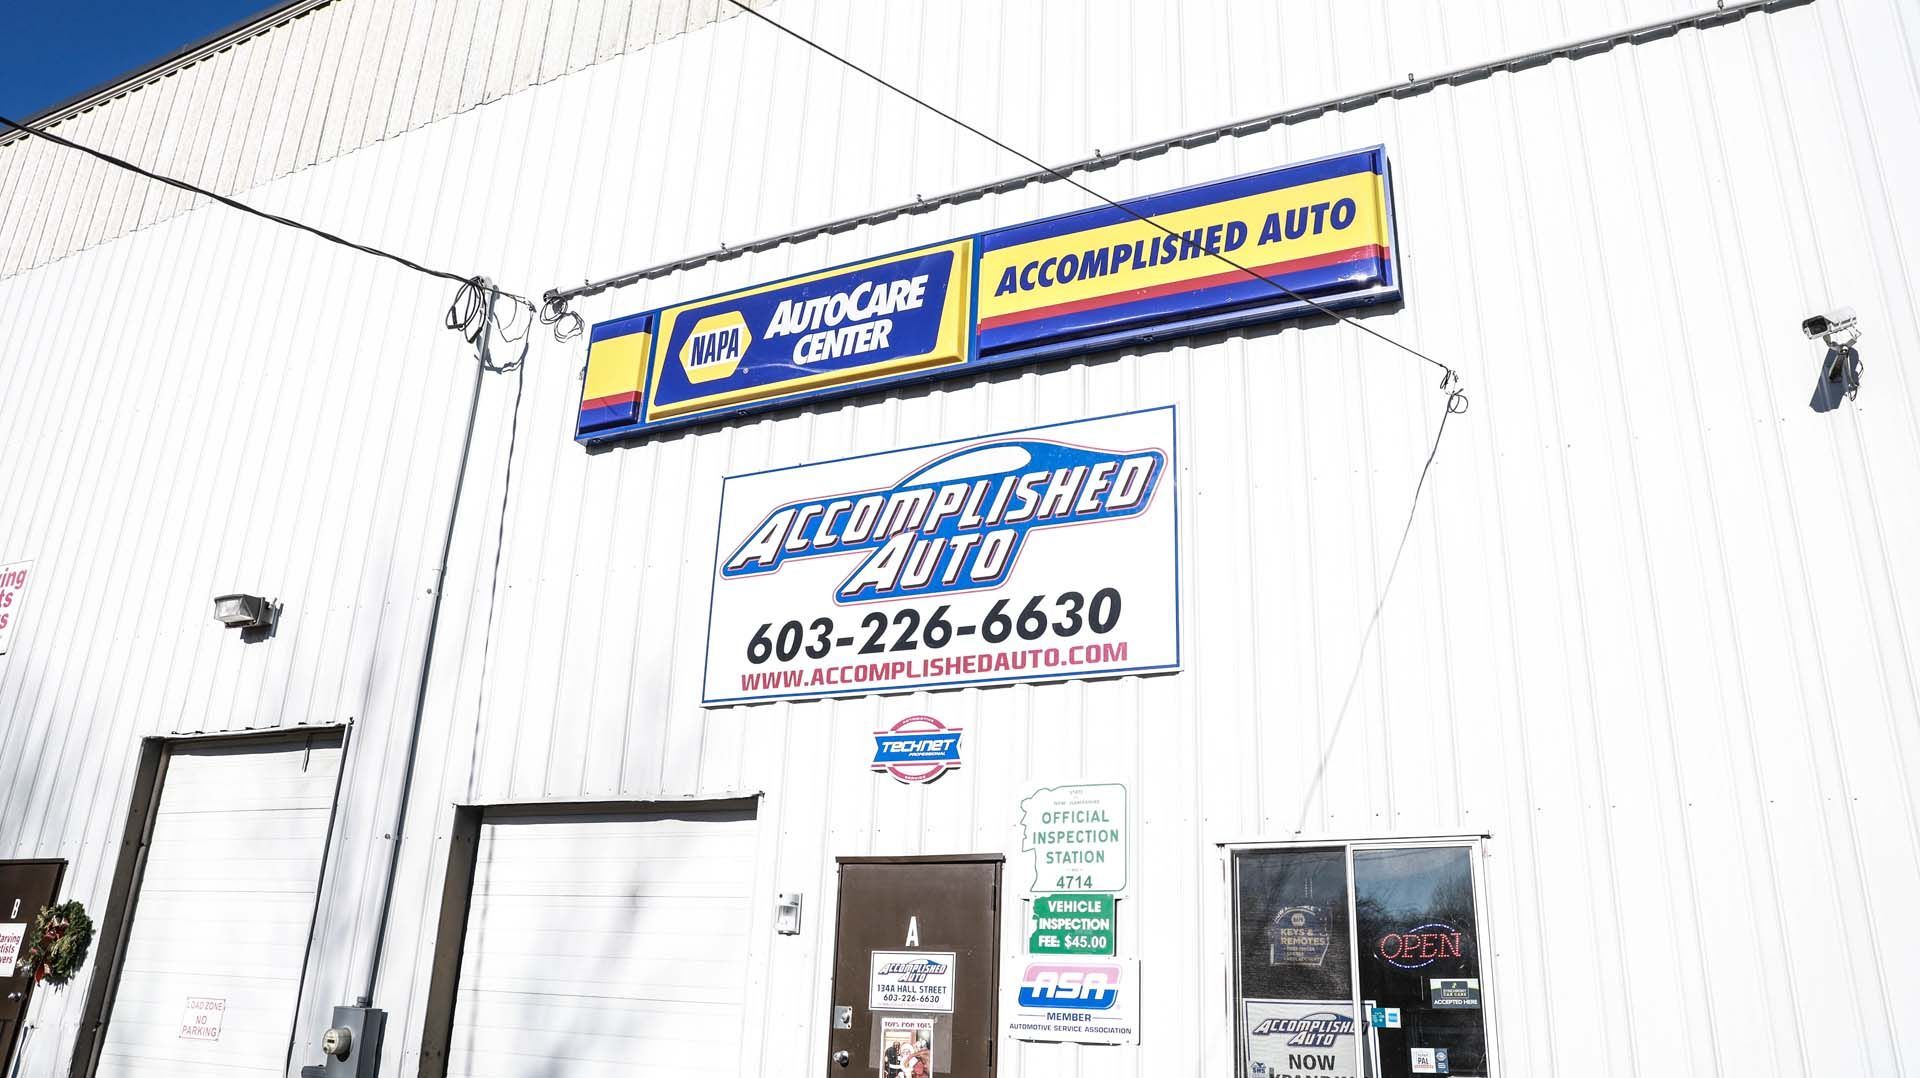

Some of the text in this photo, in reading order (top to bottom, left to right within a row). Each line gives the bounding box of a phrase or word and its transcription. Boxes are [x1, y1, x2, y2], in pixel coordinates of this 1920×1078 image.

[994, 197, 1357, 297] ACCOMPLISHED AUTO
[763, 274, 929, 340] AUTOCARE
[690, 327, 739, 367] NAPA
[792, 318, 893, 365] CENTER
[728, 455, 1158, 570] ACCOMPLISHED
[841, 529, 1017, 597] AUTO
[746, 587, 1122, 664] 603-226-6630
[741, 641, 1128, 691] WWW.ACCOMPLISHEDAUTO.COM
[1041, 809, 1110, 824] OFFICIAL
[1032, 829, 1119, 844] INSPECTION
[1046, 850, 1105, 864] STATION
[1056, 875, 1093, 889] 4714
[10, 898, 21, 919] B
[1048, 900, 1102, 913] VEHICLE
[905, 915, 919, 947] A
[1039, 918, 1110, 931] INSPECTION
[1280, 928, 1304, 936] KEYS
[1064, 934, 1107, 949] $45.00
[1280, 937, 1326, 945] REMOTES
[1380, 933, 1462, 959] OPEN
[878, 963, 948, 975] ACCOMPLISHED
[898, 973, 928, 983] AUTO
[1031, 971, 1109, 1000] ASA
[877, 984, 947, 995] 134A HALL STREET
[883, 993, 940, 1003] 603-226-6630
[205, 1001, 223, 1011] ZONE
[196, 1015, 207, 1025] NO
[1046, 1012, 1092, 1021] MEMBER
[182, 1024, 217, 1037] PARKING
[1009, 1023, 1132, 1034] AUTOMOTIVE SERVICE ASSOCIATION
[1288, 1031, 1335, 1046] AUTO
[1288, 1054, 1336, 1070] NOW
